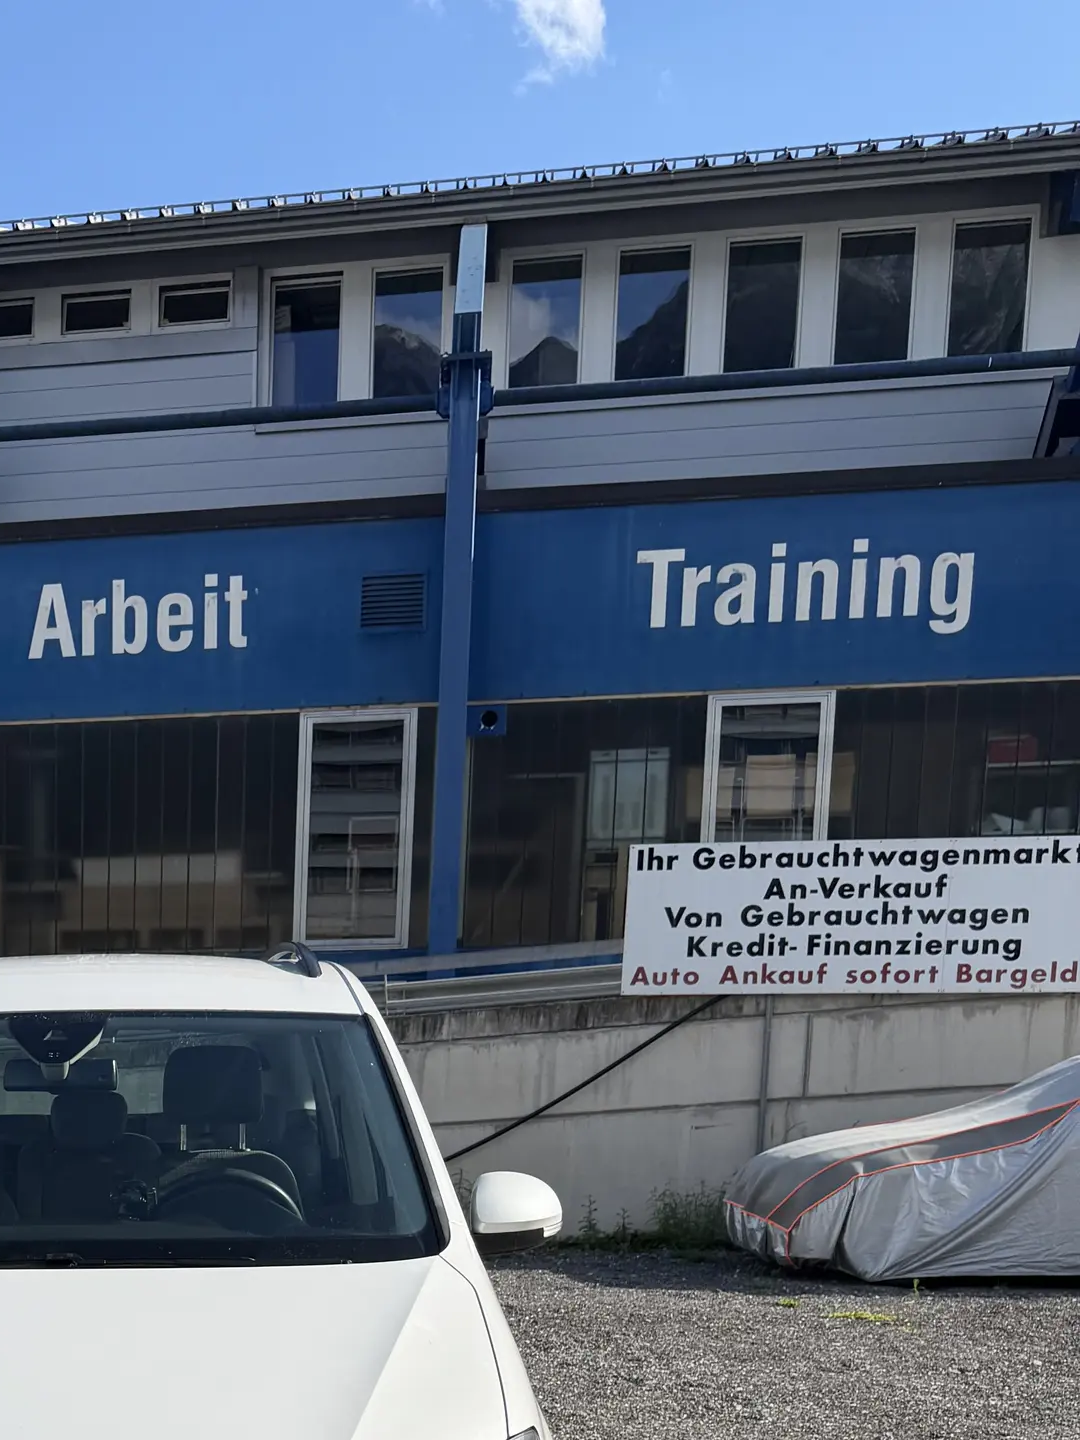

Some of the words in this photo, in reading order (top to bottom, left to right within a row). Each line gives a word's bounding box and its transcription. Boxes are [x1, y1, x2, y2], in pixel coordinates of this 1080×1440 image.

[637, 538, 975, 635] Training
[28, 573, 248, 659] Arbeit
[636, 847, 679, 871] Ihr
[763, 874, 948, 900] An-Verkauf
[664, 906, 722, 928] Von
[740, 901, 1030, 931] Gebrauchtwagen
[686, 933, 797, 957] Kredit-
[806, 931, 1022, 961] Finanzierung
[630, 966, 699, 986] Auto
[719, 962, 828, 985] Ankauf
[845, 962, 939, 984] sofort
[955, 961, 1078, 989] Bargeld
